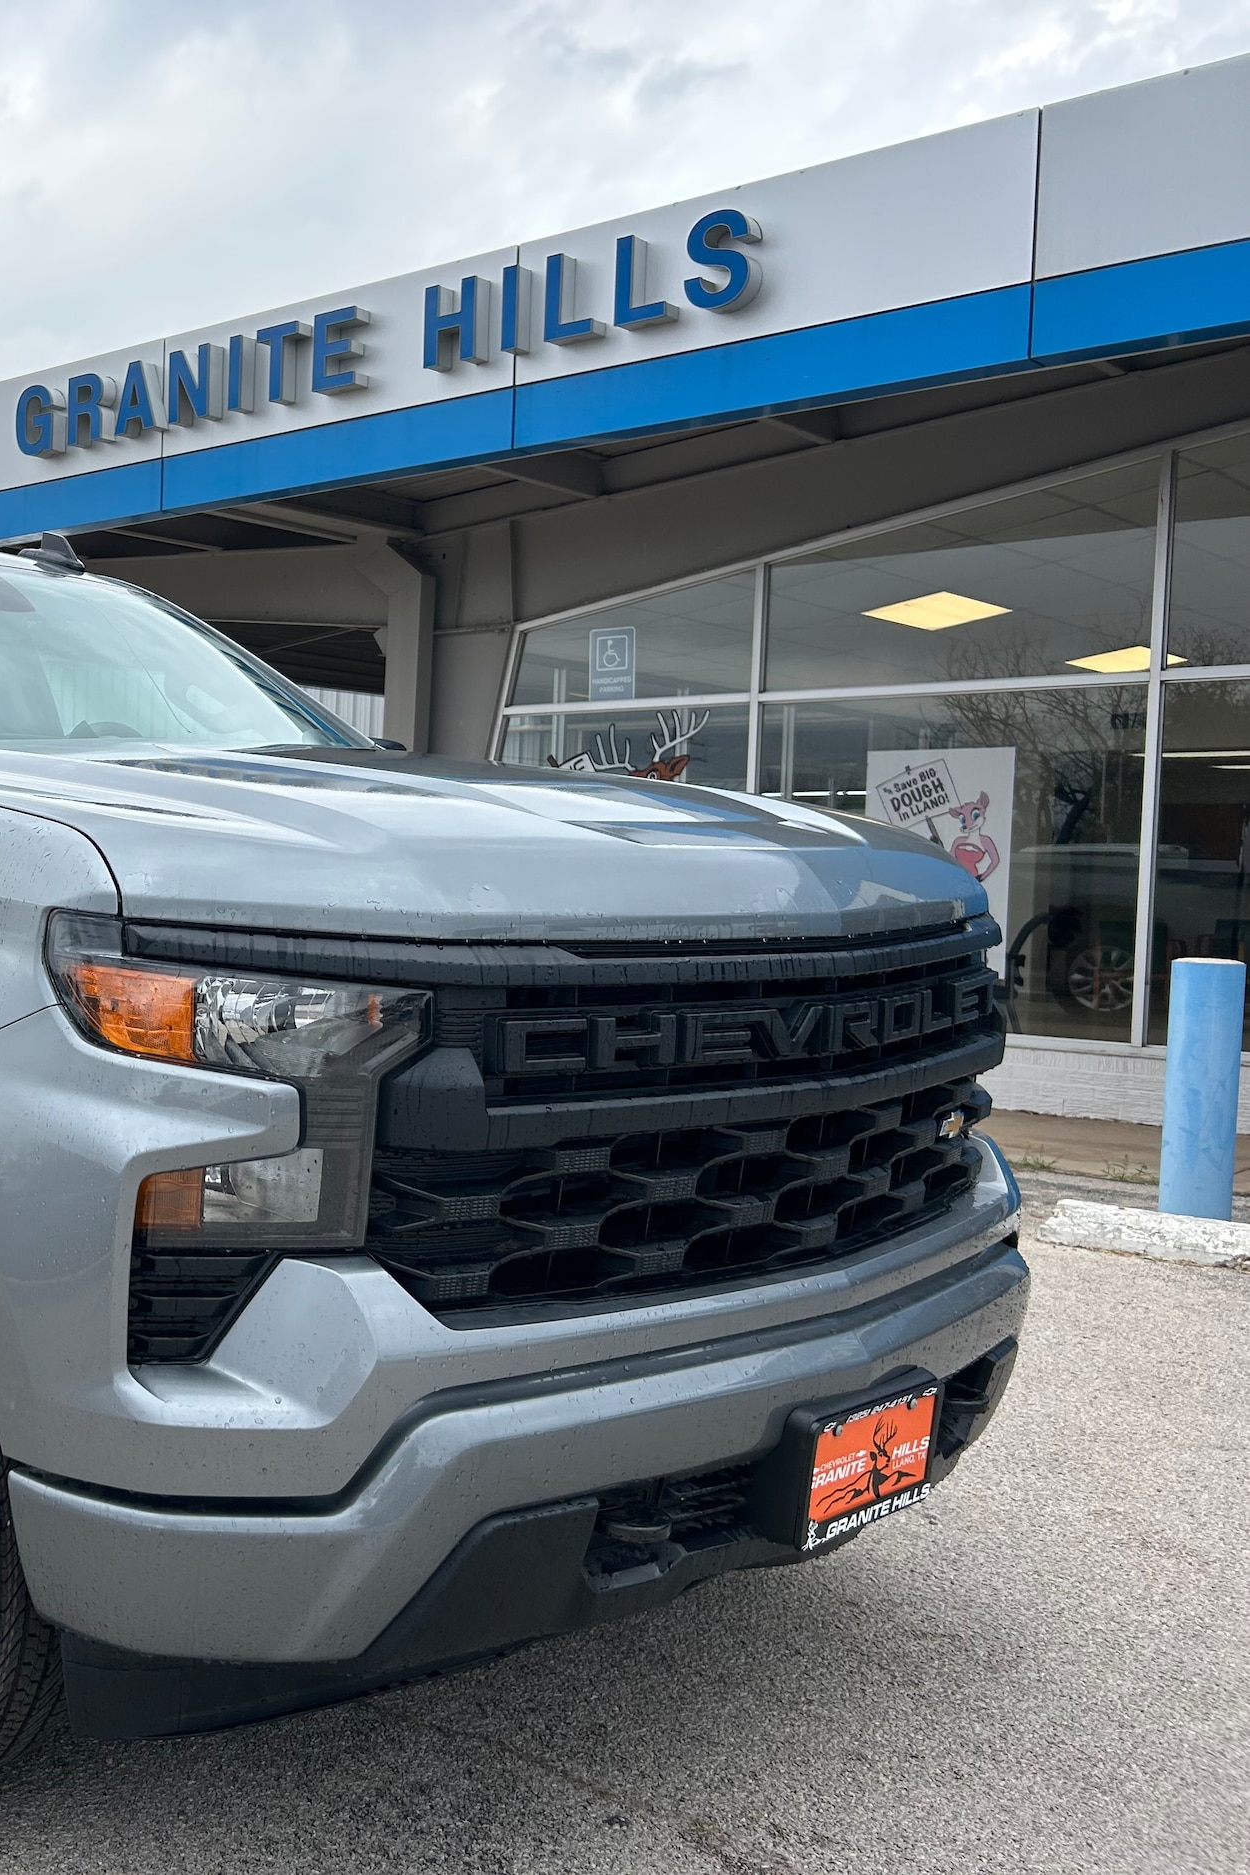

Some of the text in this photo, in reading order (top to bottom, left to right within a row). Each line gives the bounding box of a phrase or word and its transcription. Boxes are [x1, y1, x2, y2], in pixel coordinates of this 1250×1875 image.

[15, 208, 762, 459] GRANITE HILLS
[598, 685, 625, 693] PARKING
[893, 768, 937, 793] Save BIG
[890, 777, 945, 812] DOUGH
[910, 792, 950, 817] LLANO!
[892, 1435, 930, 1460] HILLS
[892, 1450, 927, 1470] LLANO, TX
[820, 1452, 856, 1471] CHEVROLET
[826, 1482, 931, 1539] GRANITE HILLS
